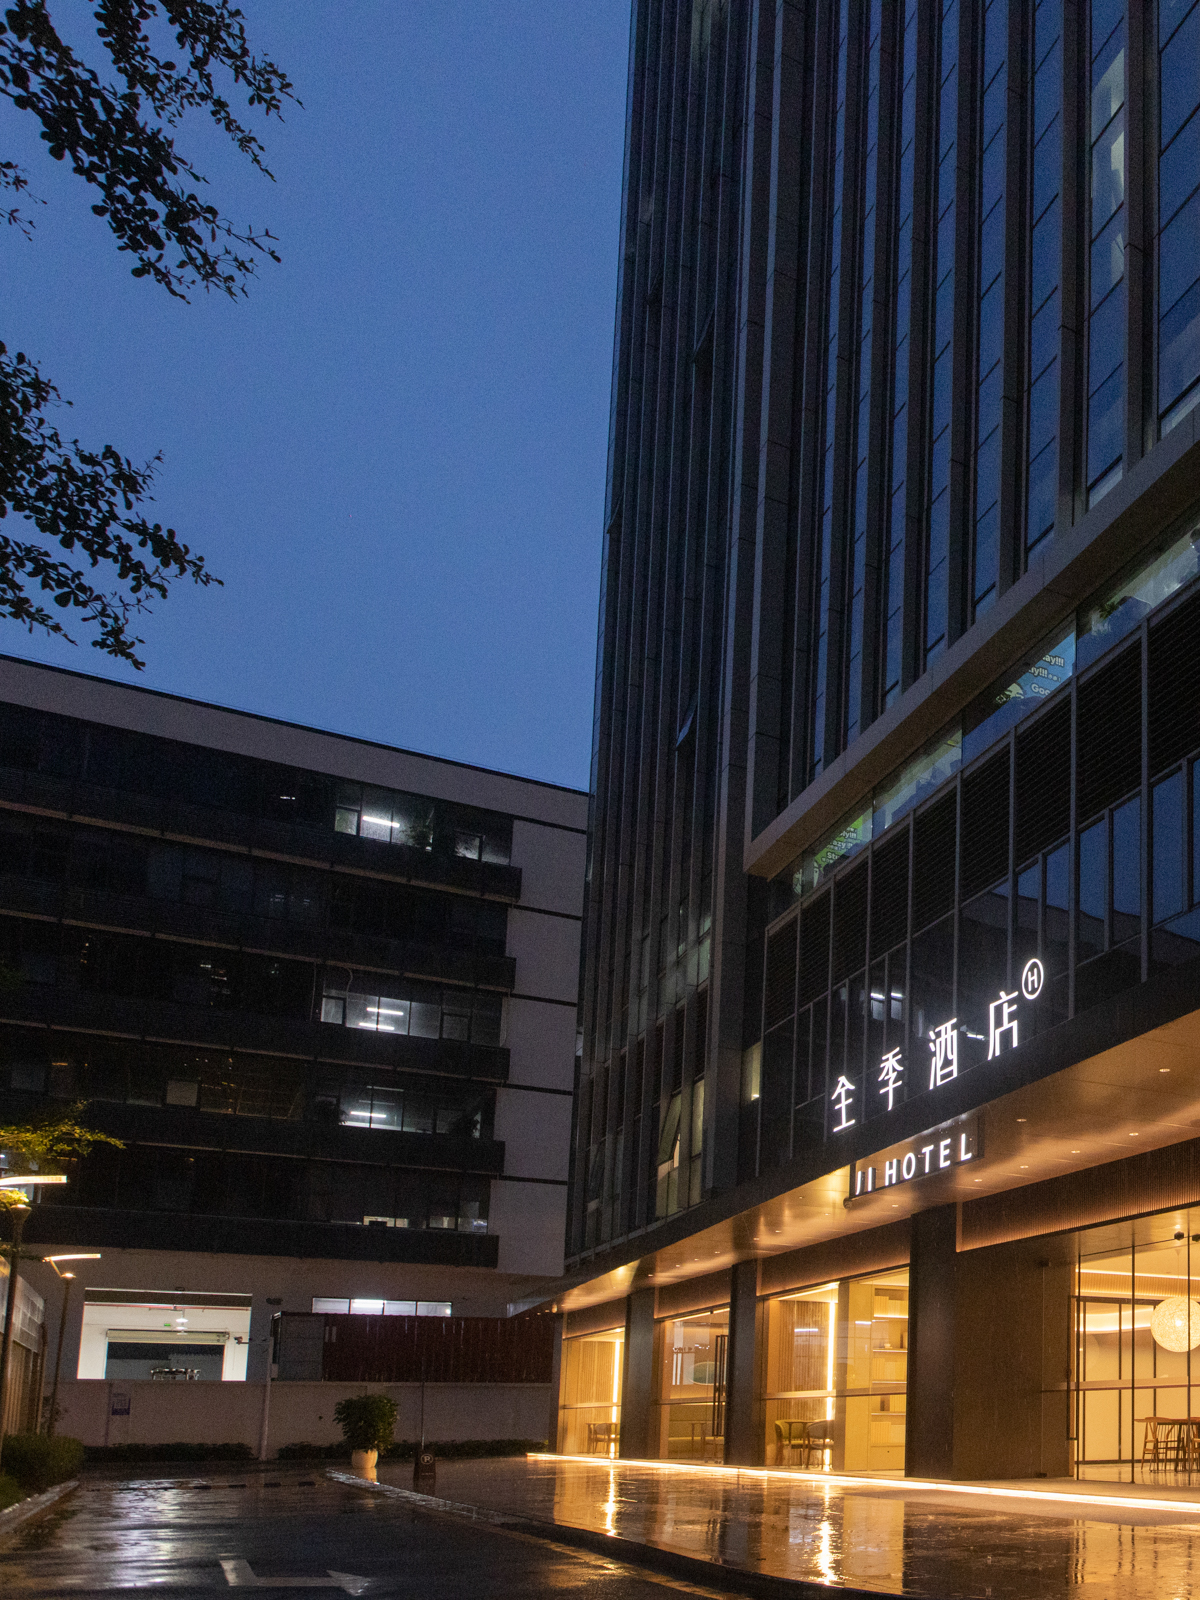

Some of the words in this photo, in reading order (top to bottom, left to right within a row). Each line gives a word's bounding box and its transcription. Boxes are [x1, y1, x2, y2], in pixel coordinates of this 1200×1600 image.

[832, 991, 1019, 1133] 全季酒店
[855, 1167, 873, 1196] JI
[884, 1133, 973, 1187] HOTEL
